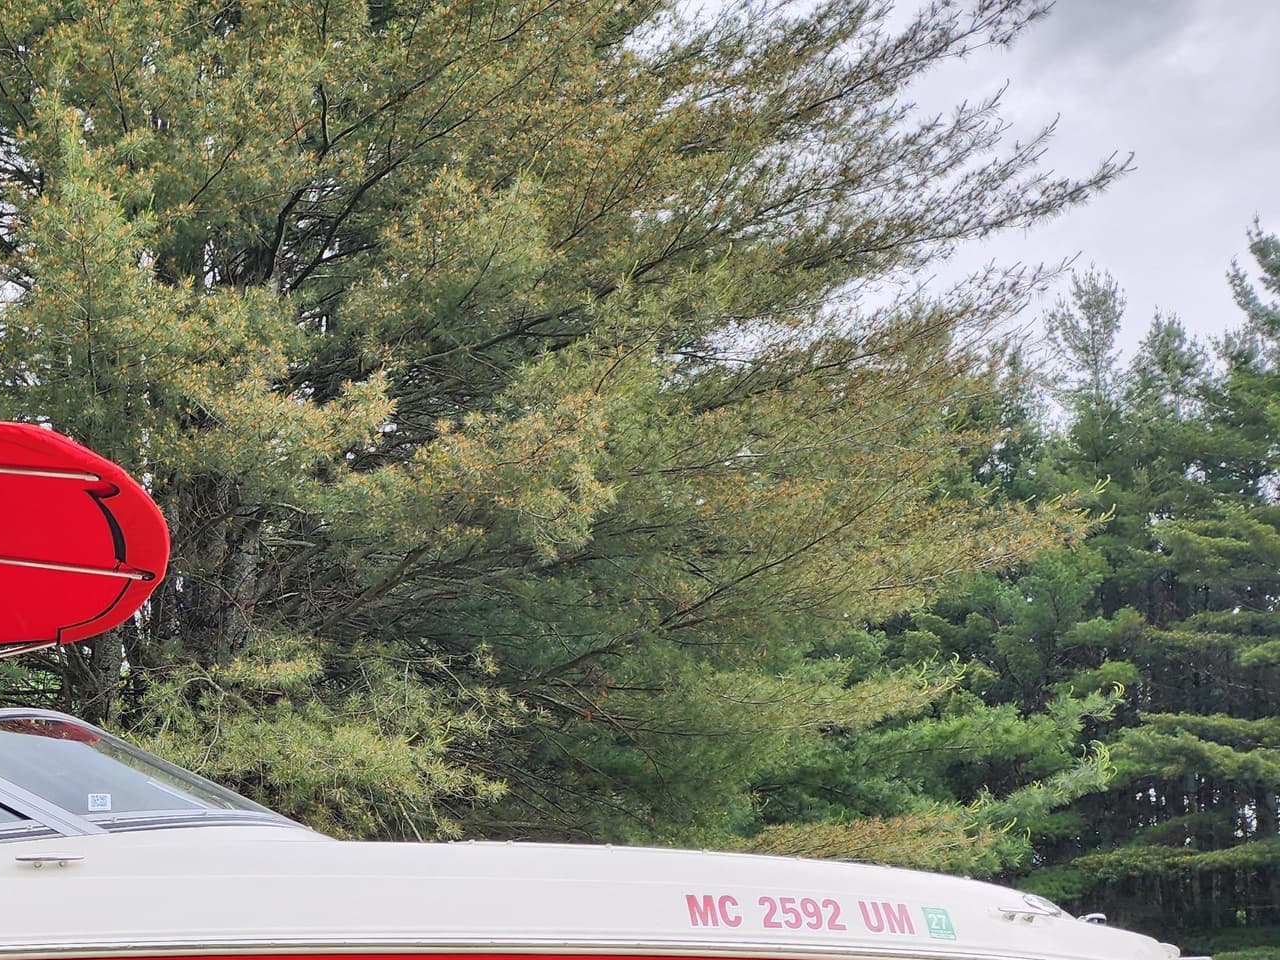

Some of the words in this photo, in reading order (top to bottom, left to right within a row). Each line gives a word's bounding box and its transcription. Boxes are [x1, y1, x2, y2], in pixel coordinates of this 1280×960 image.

[685, 894, 742, 928] MC
[757, 896, 847, 931] 2592
[858, 900, 916, 935] UM
